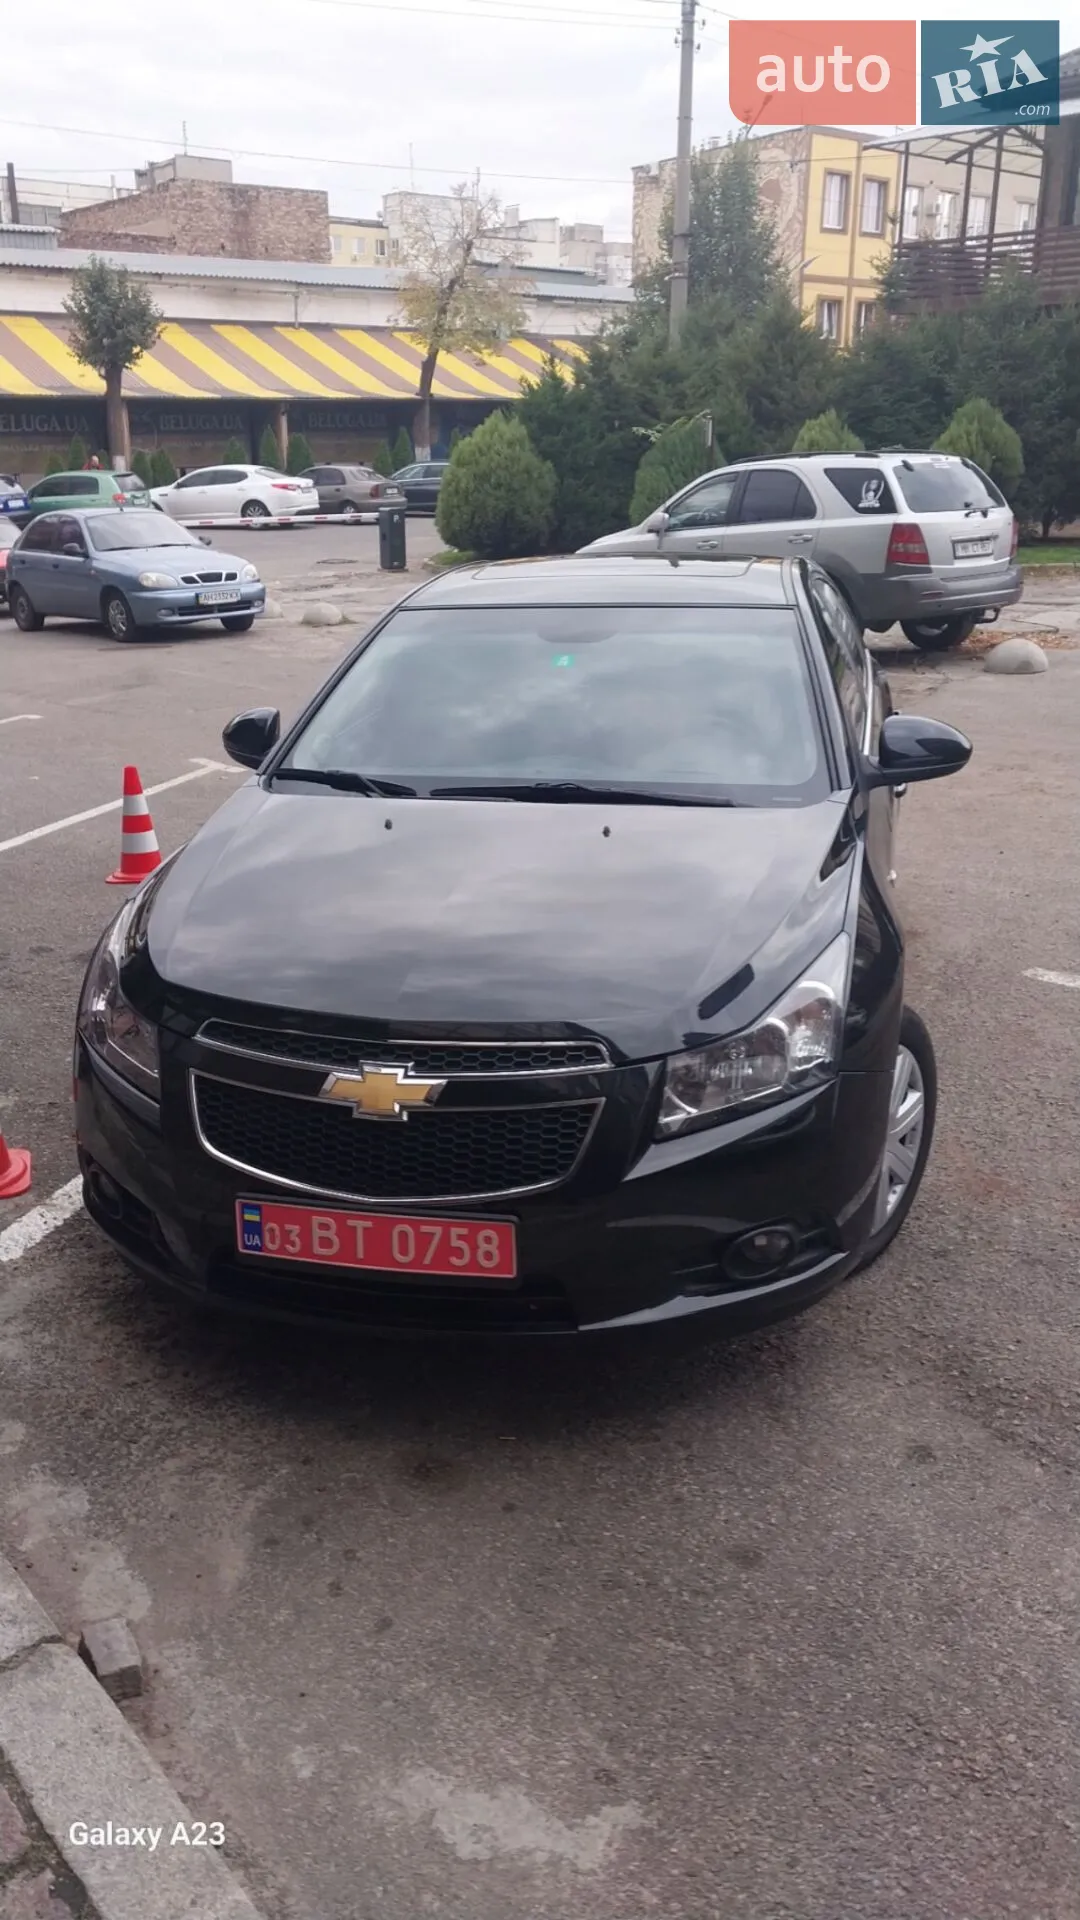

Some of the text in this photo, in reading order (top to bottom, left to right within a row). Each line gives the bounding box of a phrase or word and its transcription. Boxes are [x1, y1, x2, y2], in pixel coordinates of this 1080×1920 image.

[244, 1233, 261, 1248] UA
[264, 1216, 500, 1268] 03 BT 0758
